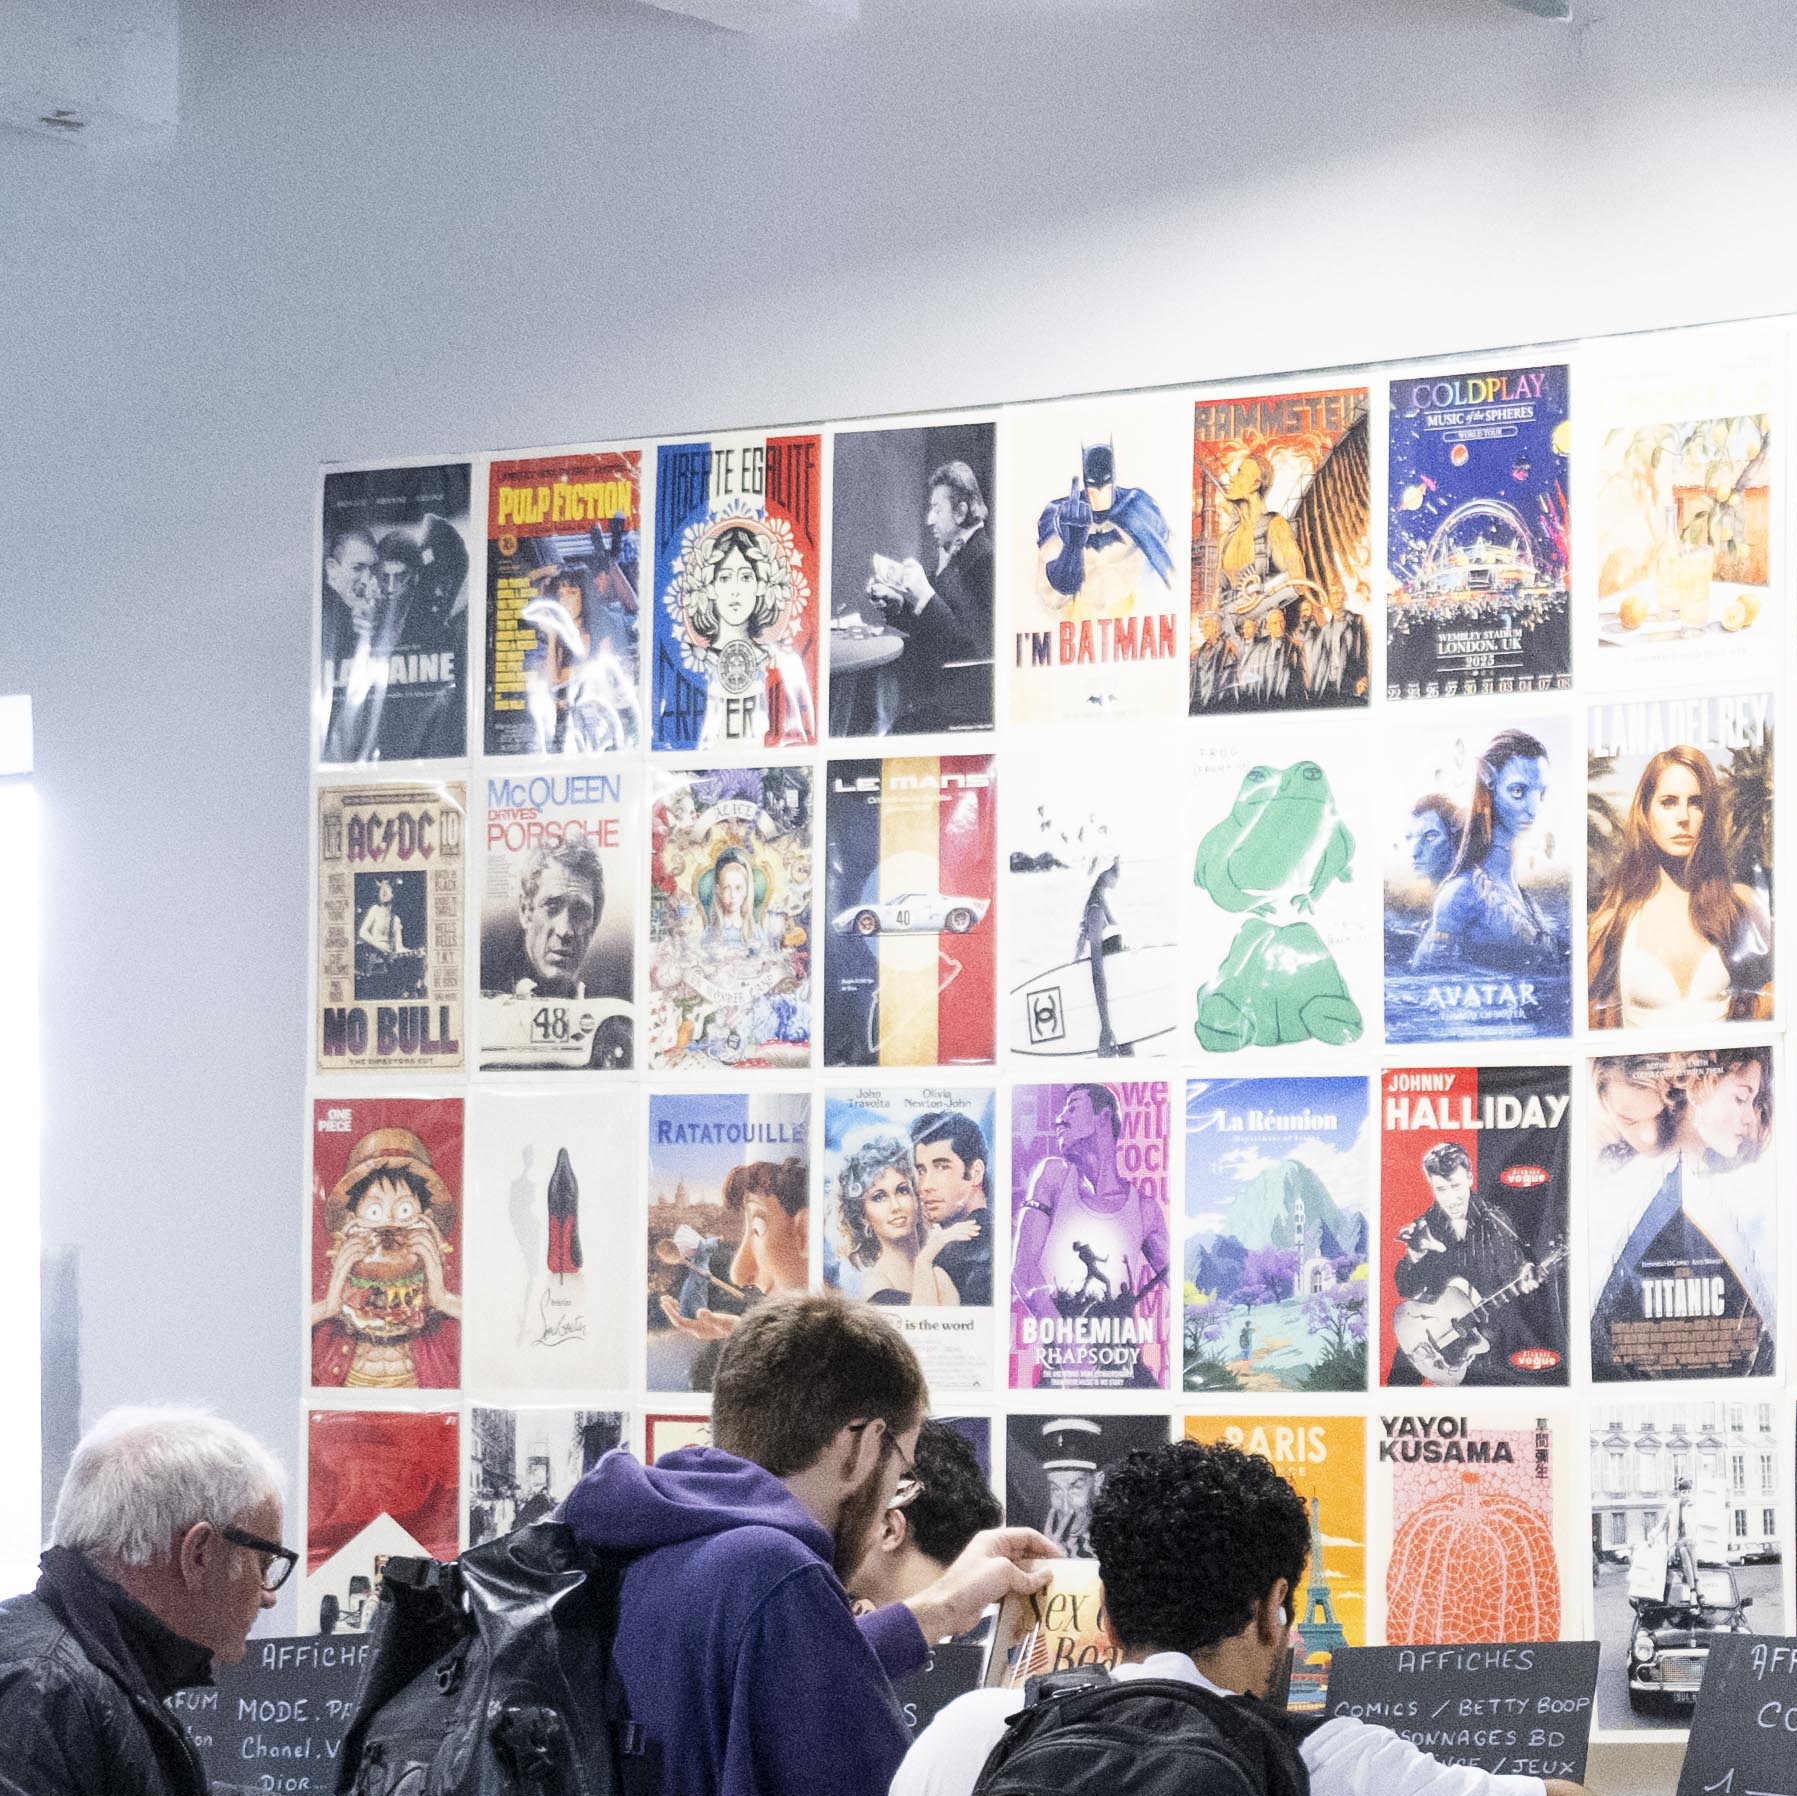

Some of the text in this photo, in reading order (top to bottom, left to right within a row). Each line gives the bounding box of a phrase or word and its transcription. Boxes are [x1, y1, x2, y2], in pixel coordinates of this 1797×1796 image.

[1412, 373, 1546, 409] COLDPLAY
[1427, 407, 1534, 427] MUSIC SPHERES
[498, 480, 632, 525] PULP FICTION
[1016, 613, 1177, 668] I'M BATMAN
[1503, 638, 1522, 650] UK
[488, 774, 621, 813] McQUEEN
[834, 777, 880, 793] LE
[488, 807, 538, 821] DRIVES
[487, 818, 621, 851] PORSCHE
[1429, 983, 1540, 1010] AVATAR
[323, 1006, 460, 1057] NO BULL
[533, 1006, 567, 1040] 48
[1388, 1073, 1457, 1092] JOHNNY
[328, 1108, 352, 1121] ONE
[904, 1099, 972, 1109] Newton-John
[1385, 1094, 1571, 1131] HALLIDAY
[317, 1120, 352, 1132] PIECE
[1218, 1107, 1338, 1132] La Réunion
[656, 1120, 804, 1146] RATATOUILLE
[1641, 1276, 1725, 1319] TITANIC
[920, 1318, 975, 1331] the word
[1022, 1316, 1154, 1344] BOHEMIAN
[1033, 1347, 1141, 1369] RHAPSODY
[1380, 1415, 1469, 1440] YAYOI
[1224, 1425, 1328, 1466] PARIS
[1379, 1440, 1515, 1464] KUSAMA
[1459, 1697, 1530, 1717] BETTY
[1537, 1696, 1591, 1715] BOOP
[1511, 1758, 1576, 1776] JEUX
